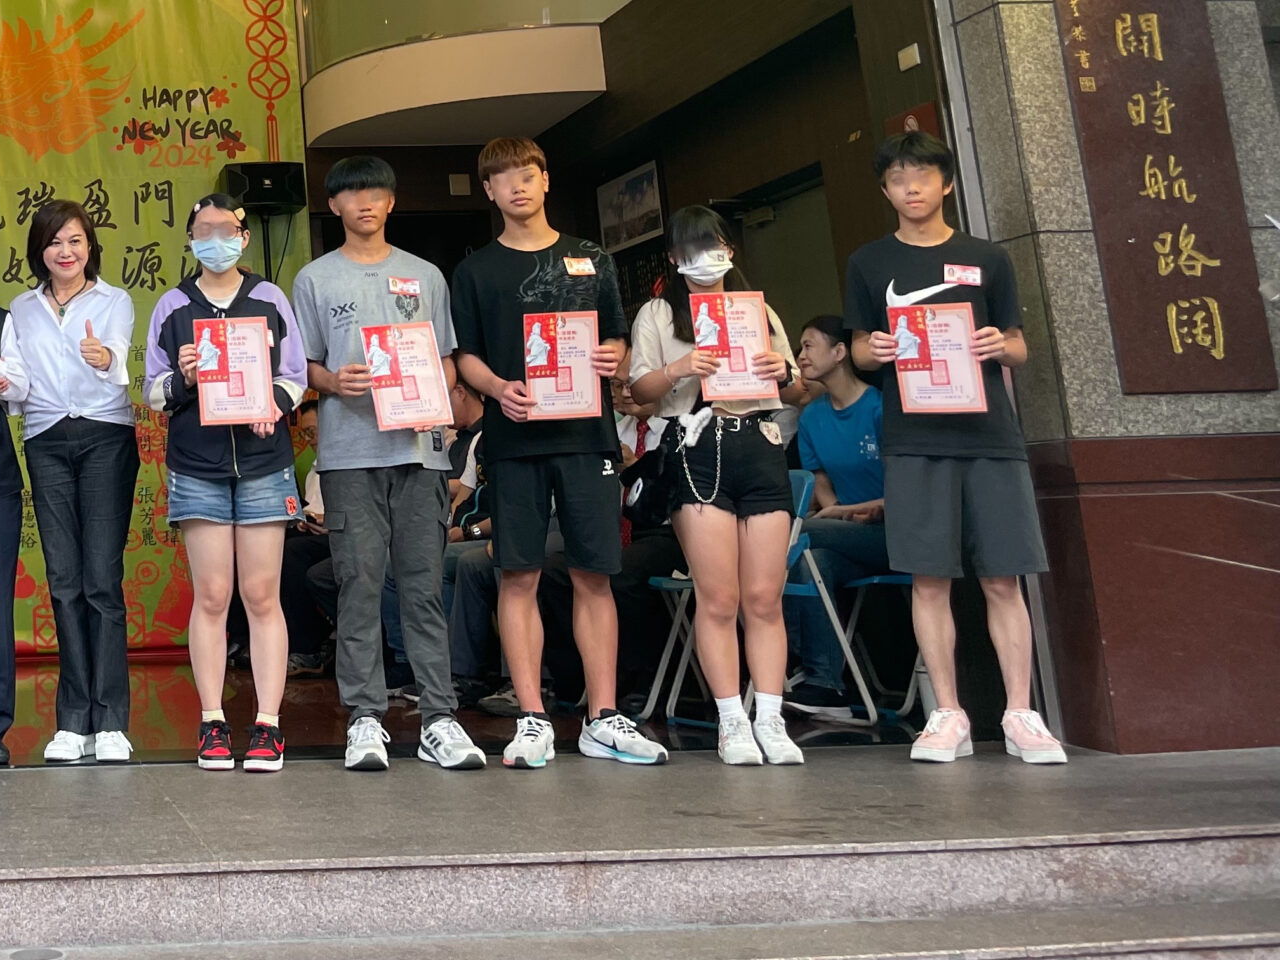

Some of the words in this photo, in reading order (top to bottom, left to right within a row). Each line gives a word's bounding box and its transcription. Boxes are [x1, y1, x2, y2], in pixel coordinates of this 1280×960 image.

[142, 85, 216, 116] HAPPY
[121, 117, 171, 145] NEW
[175, 117, 241, 148] YEAR
[148, 143, 217, 169] 2024
[138, 486, 157, 547] 張芳麗
